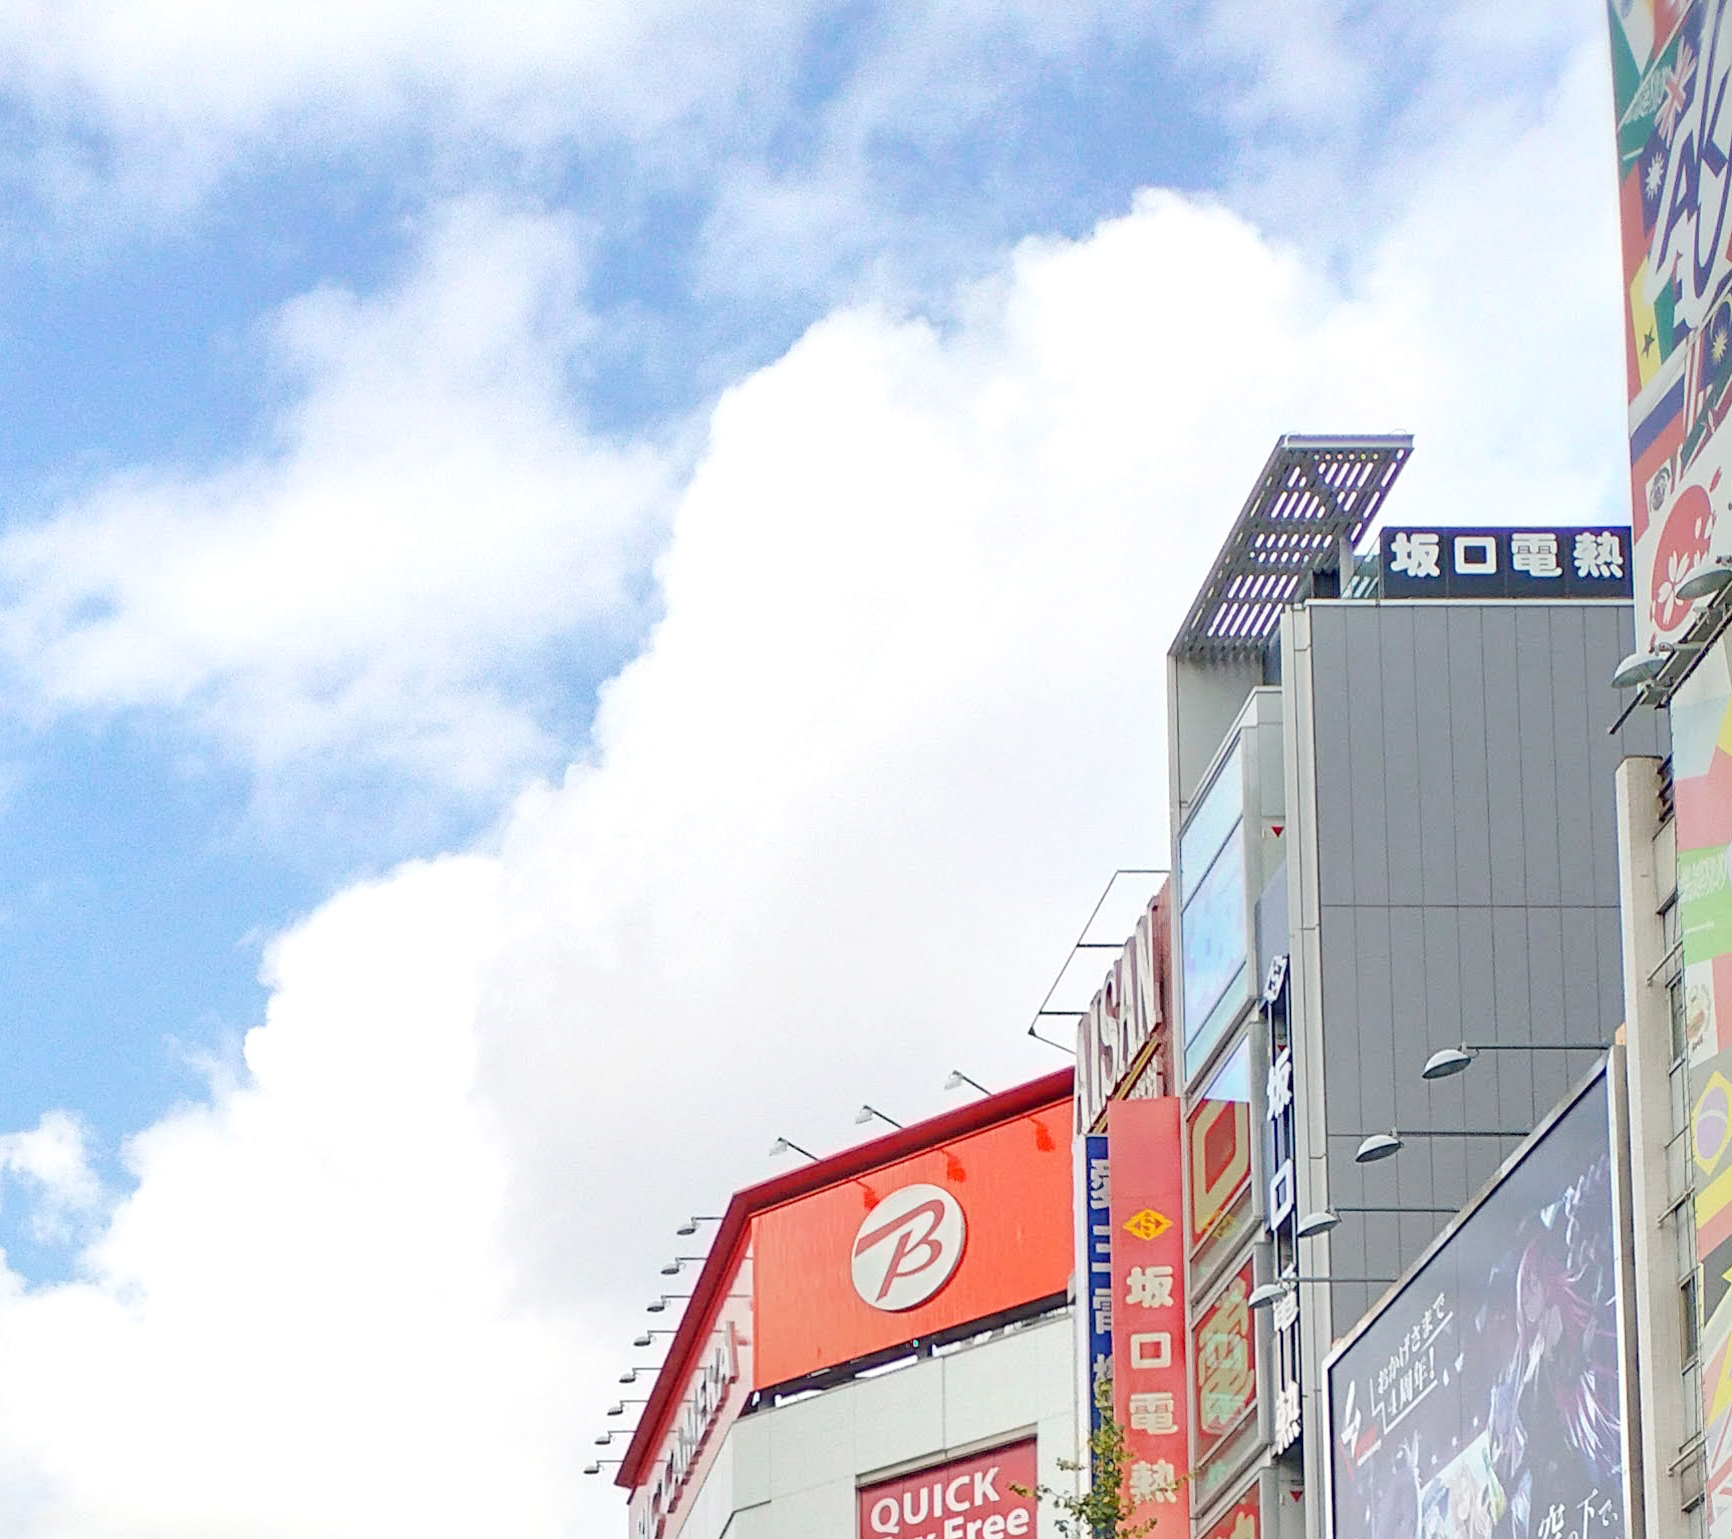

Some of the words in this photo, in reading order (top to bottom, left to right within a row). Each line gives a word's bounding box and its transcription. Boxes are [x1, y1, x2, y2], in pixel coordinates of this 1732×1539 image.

[1390, 531, 1624, 578] 坂口電熱
[1125, 1265, 1180, 1504] 坂口電熱
[1378, 1292, 1446, 1395] おかげさまで
[870, 1466, 1001, 1534] QUICK
